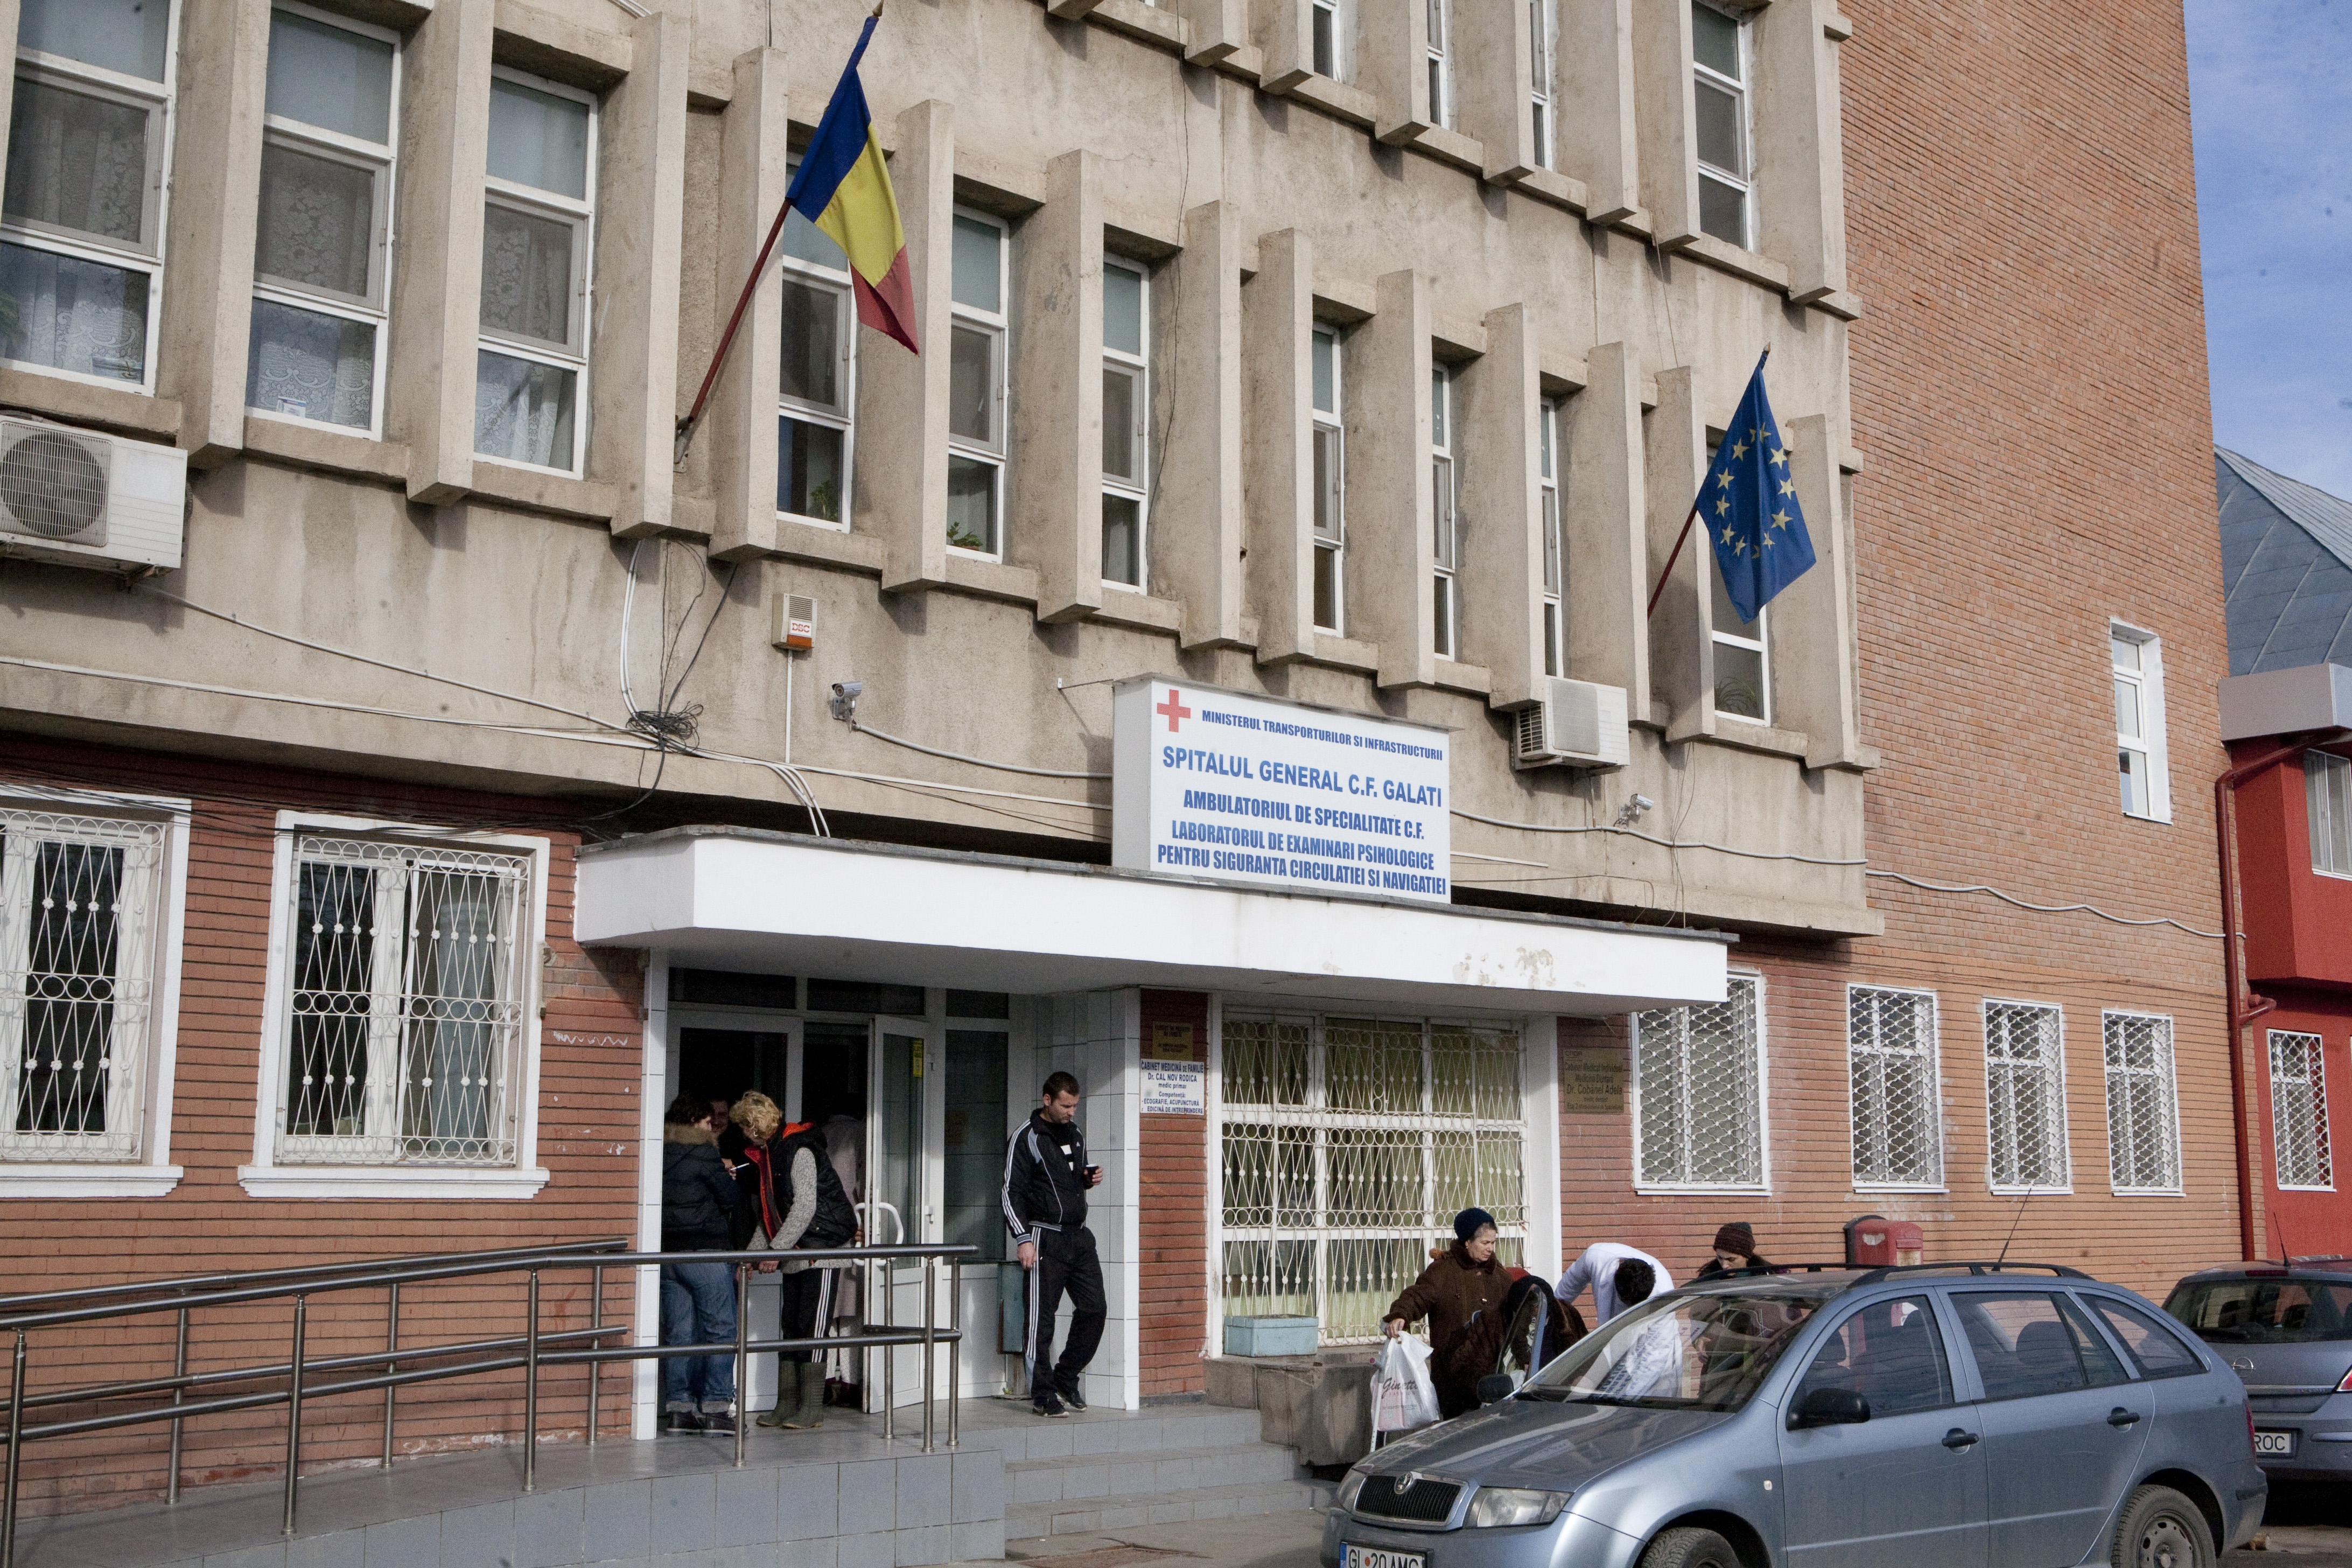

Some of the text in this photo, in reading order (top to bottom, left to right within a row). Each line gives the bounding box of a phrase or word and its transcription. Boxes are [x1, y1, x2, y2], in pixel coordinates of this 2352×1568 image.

[1202, 710, 1443, 761] MINISTERUL TRANSPORTURILOR SI INFRASTRUCTURII
[1163, 745, 1441, 808] SPITALUL GENERAL C.F. GALATI
[1184, 789, 1424, 839] AMBULATORIUL DE SPECIALITATE C.F.
[1158, 844, 1446, 895] PENTRU SIGURANTA CIRCULATIEI SI NAVIGATIEI
[1172, 820, 1434, 870] LABORATORUL DE EXAMINARI PSIHOLOGICE
[1142, 1061, 1160, 1070] CABINET
[1179, 1074, 1198, 1082] RODICA
[2254, 1434, 2285, 1451] ROC
